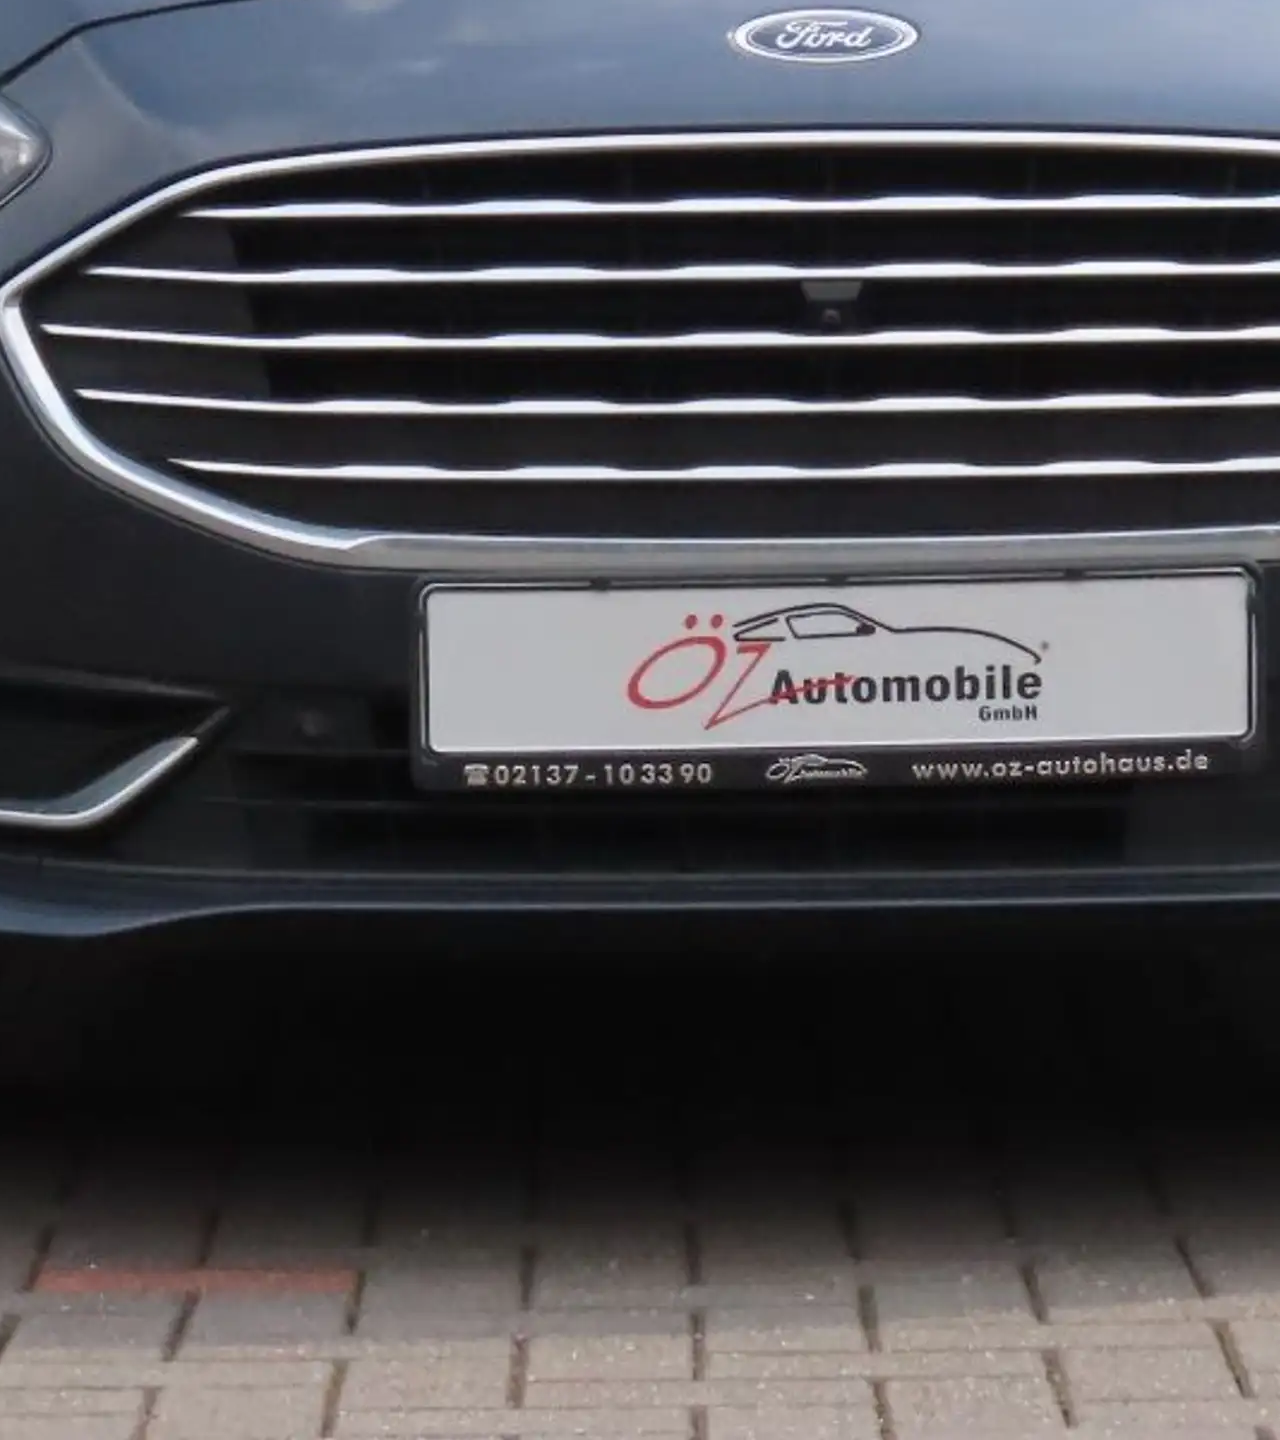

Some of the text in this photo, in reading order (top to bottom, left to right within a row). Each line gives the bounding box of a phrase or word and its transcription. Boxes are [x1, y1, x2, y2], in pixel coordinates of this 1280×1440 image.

[775, 20, 874, 49] Ford
[770, 664, 1043, 705] Automobile
[978, 705, 1038, 722] GmbH
[911, 749, 1209, 780] www.oz-autohaus.de
